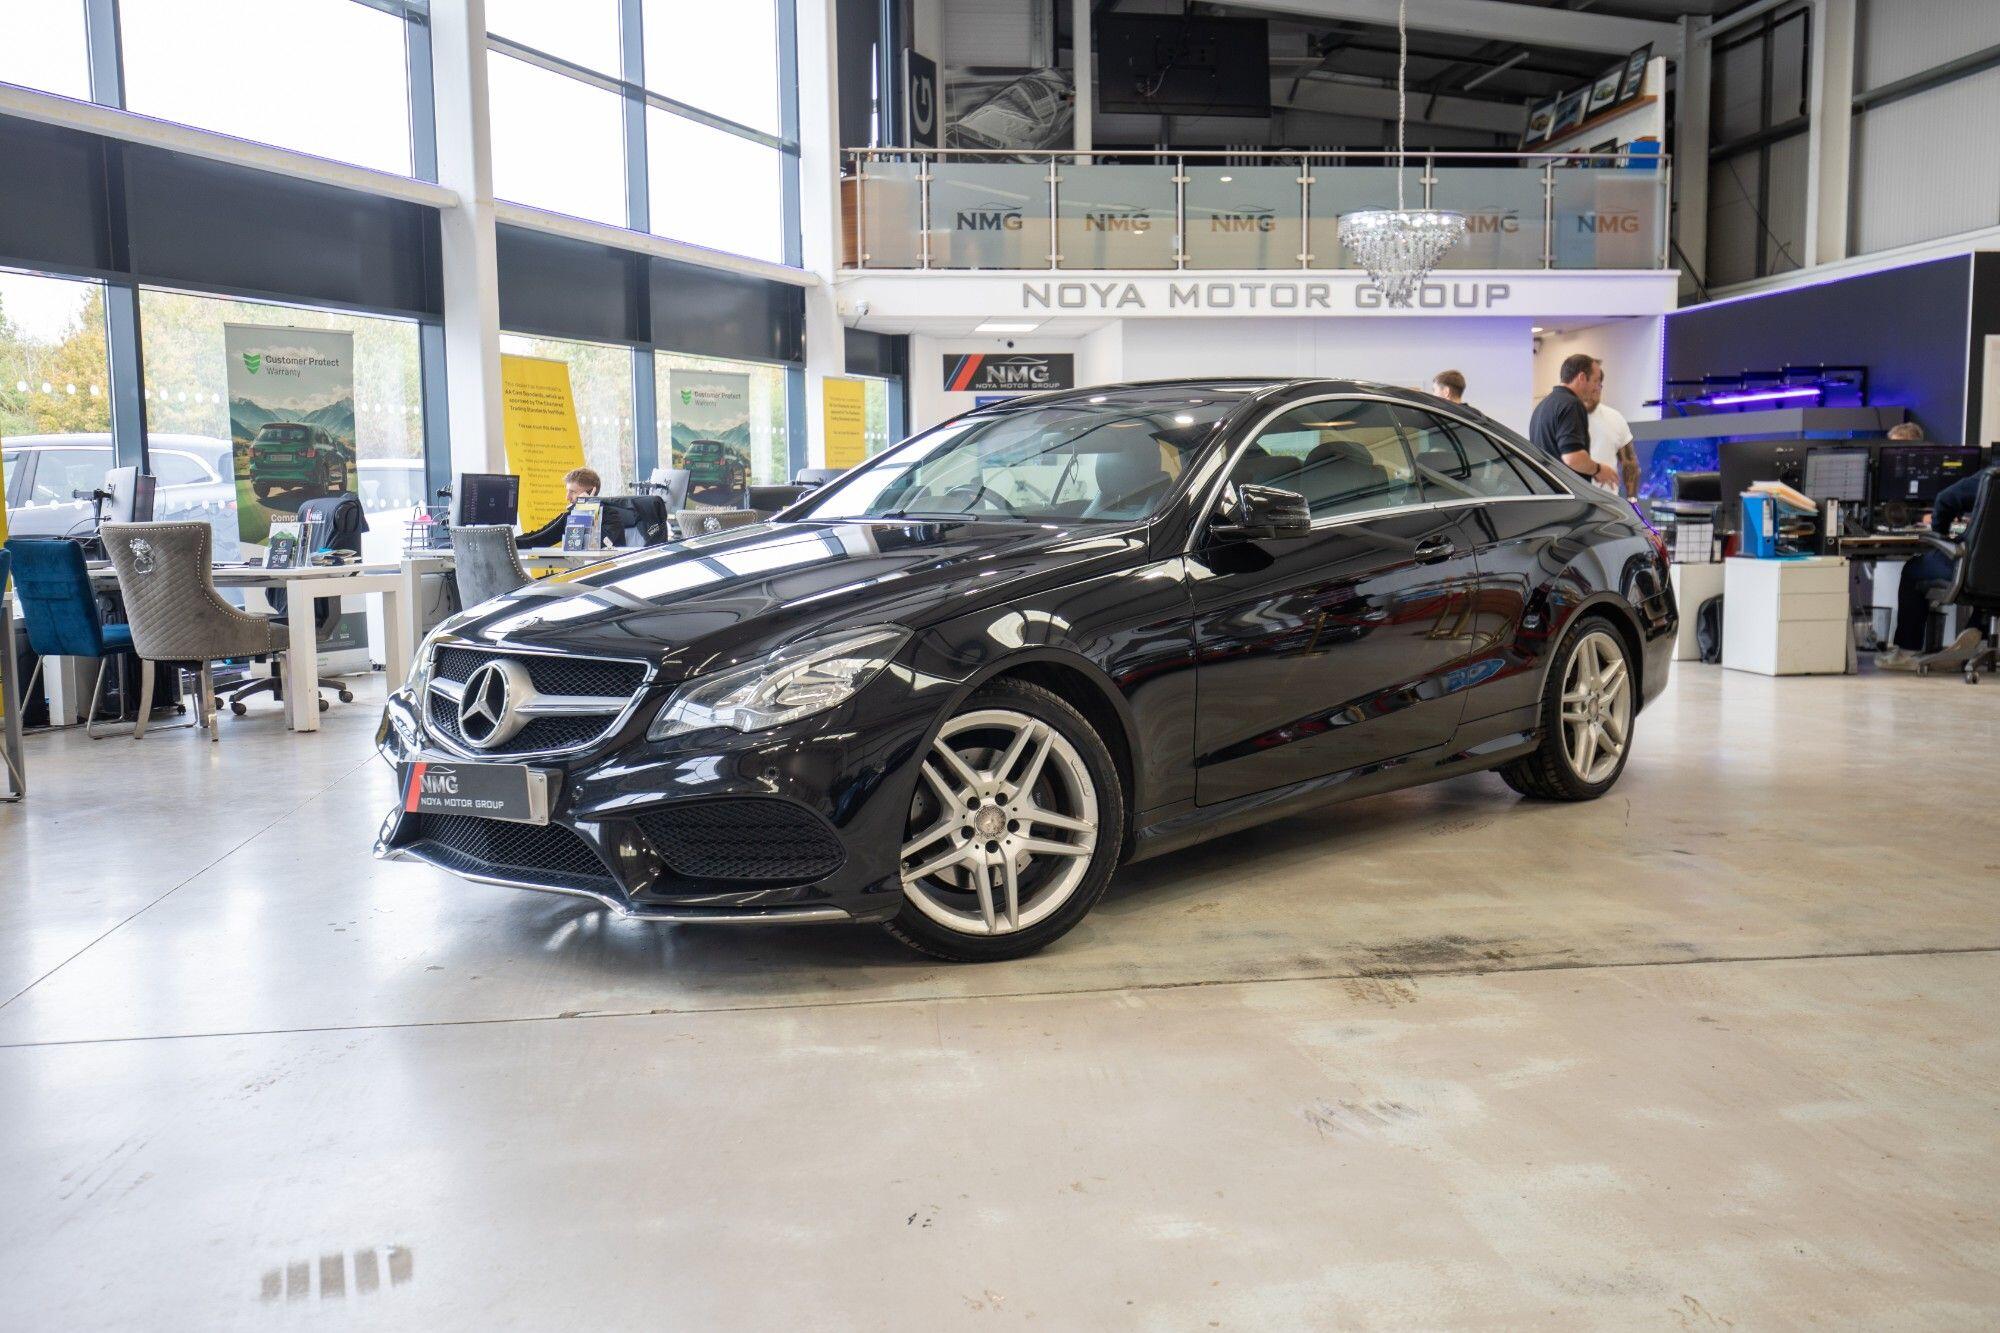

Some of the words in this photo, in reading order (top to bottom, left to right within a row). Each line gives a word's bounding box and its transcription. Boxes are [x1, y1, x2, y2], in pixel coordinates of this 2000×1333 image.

[956, 212, 1023, 231] NMG
[1085, 213, 1151, 232] NMG
[1211, 214, 1276, 232] NMG
[1577, 215, 1640, 234] NMG
[1022, 283, 1146, 308] NOYA
[1169, 283, 1332, 308] MOTOR
[265, 355, 306, 365] Customer
[308, 357, 340, 367] Protect
[266, 367, 301, 378] Warranty
[986, 365, 1050, 383] NMG
[419, 775, 459, 794] NMG
[421, 797, 442, 806] NOYA
[444, 798, 473, 808] MOTOR
[474, 799, 505, 809] GROUP
